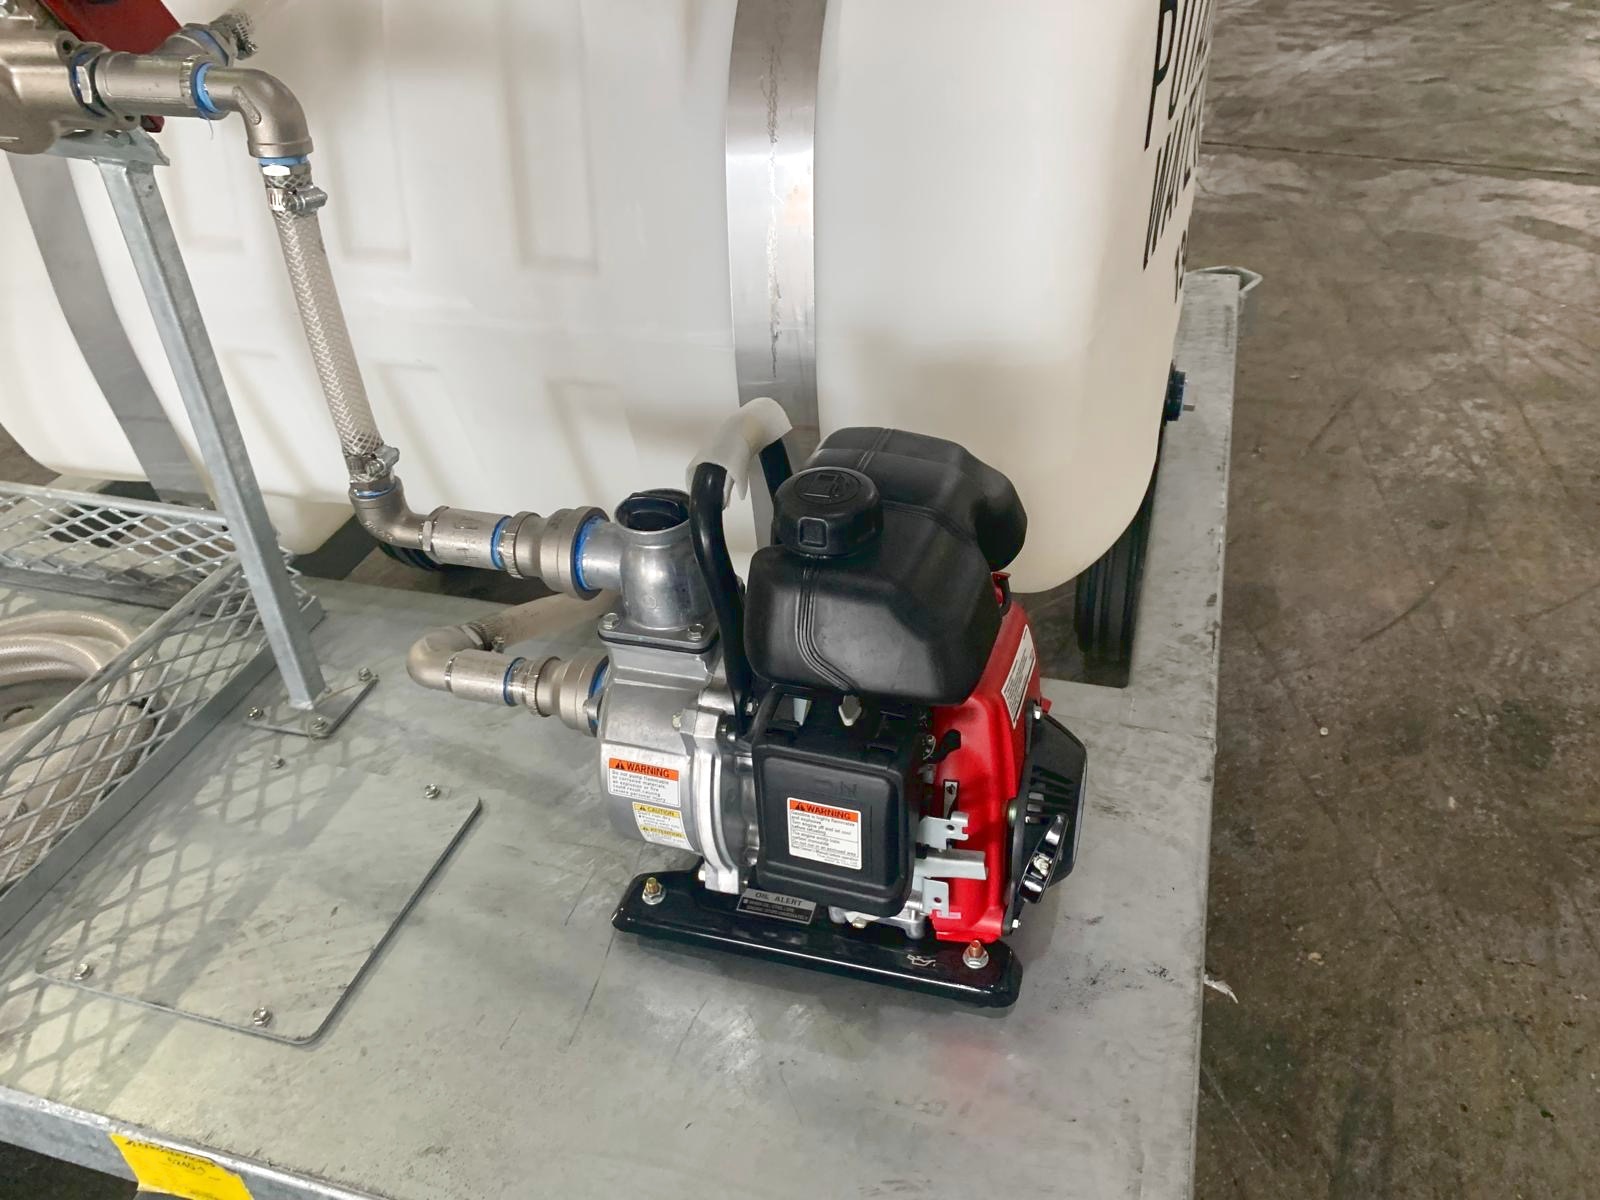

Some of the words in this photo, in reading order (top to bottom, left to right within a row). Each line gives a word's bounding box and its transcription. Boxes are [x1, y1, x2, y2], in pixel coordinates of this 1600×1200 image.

[627, 762, 670, 778] WARNING
[807, 805, 850, 819] WARNING
[774, 896, 802, 906] ALERT
